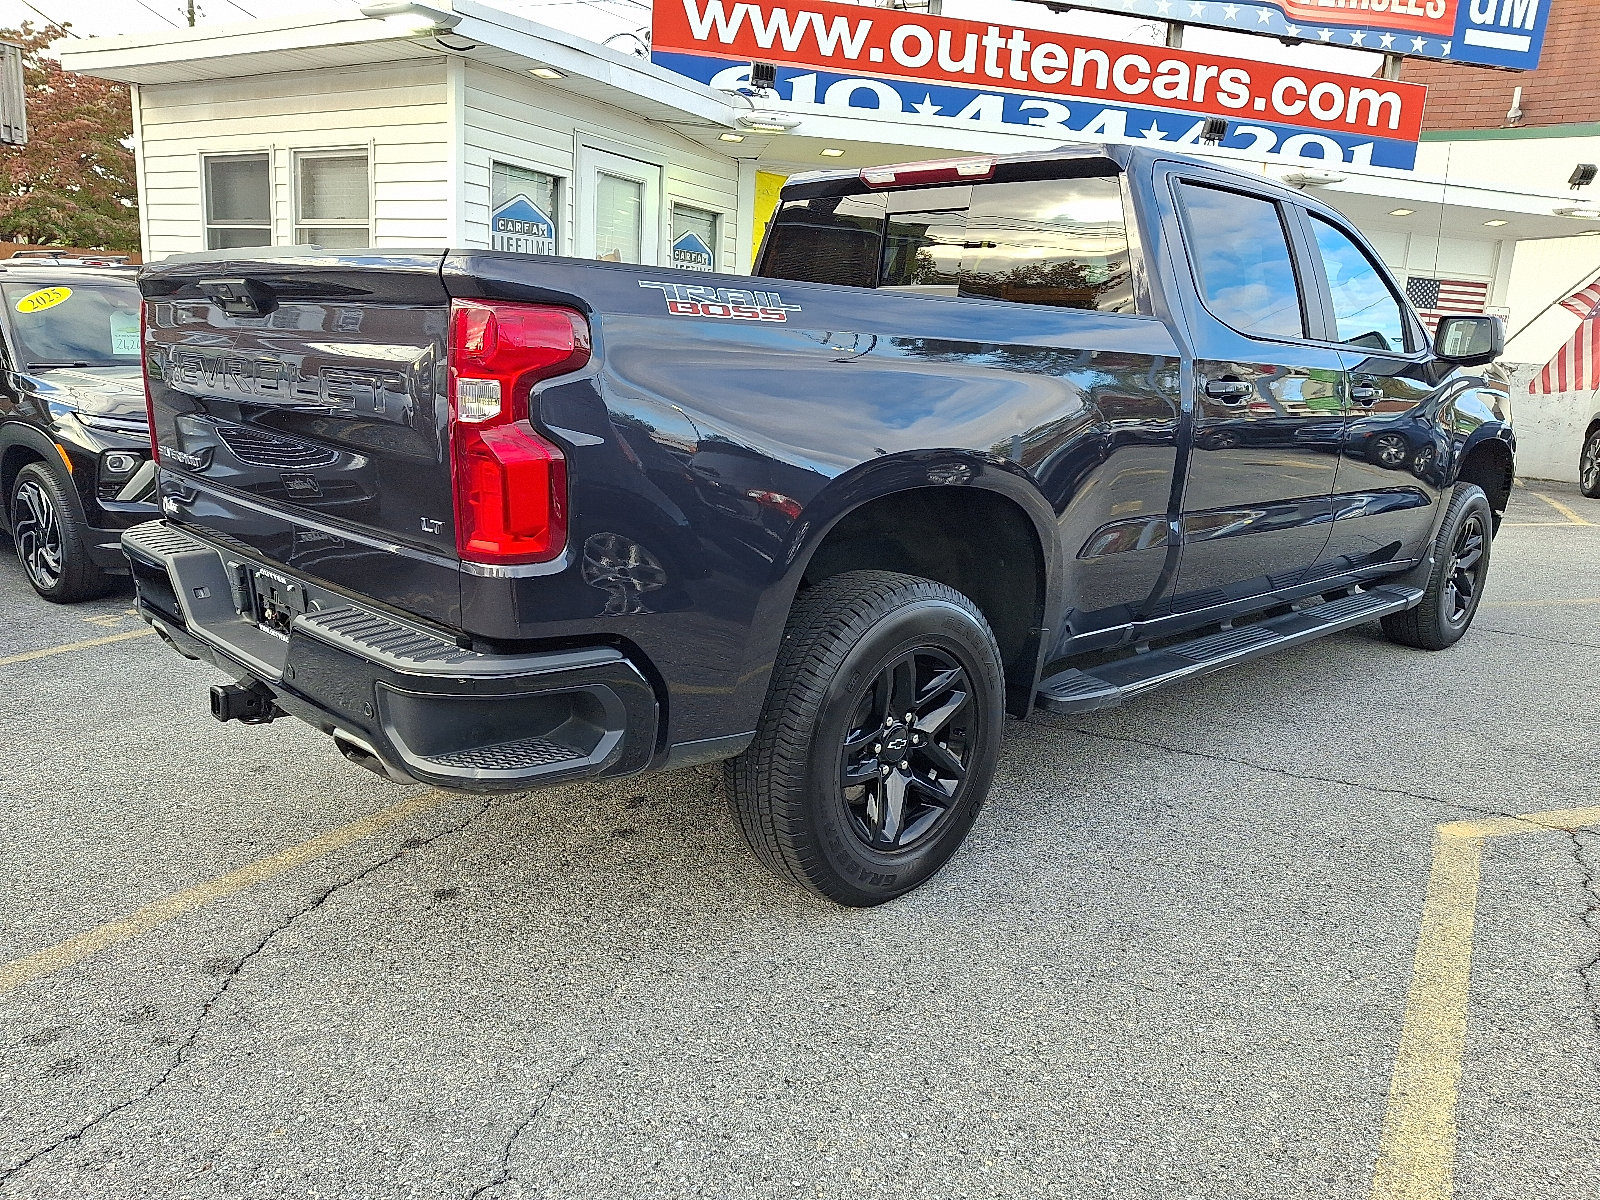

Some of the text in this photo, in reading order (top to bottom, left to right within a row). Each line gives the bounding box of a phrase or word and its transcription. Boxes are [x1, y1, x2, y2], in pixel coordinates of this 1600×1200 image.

[682, 0, 1402, 131] www.outtencars.com
[497, 217, 547, 238] CARFAX
[674, 249, 707, 265] CARFAX
[26, 288, 62, 311] 2025
[638, 280, 802, 312] TRAIL
[669, 300, 788, 323] BOSS
[420, 516, 446, 535] LT
